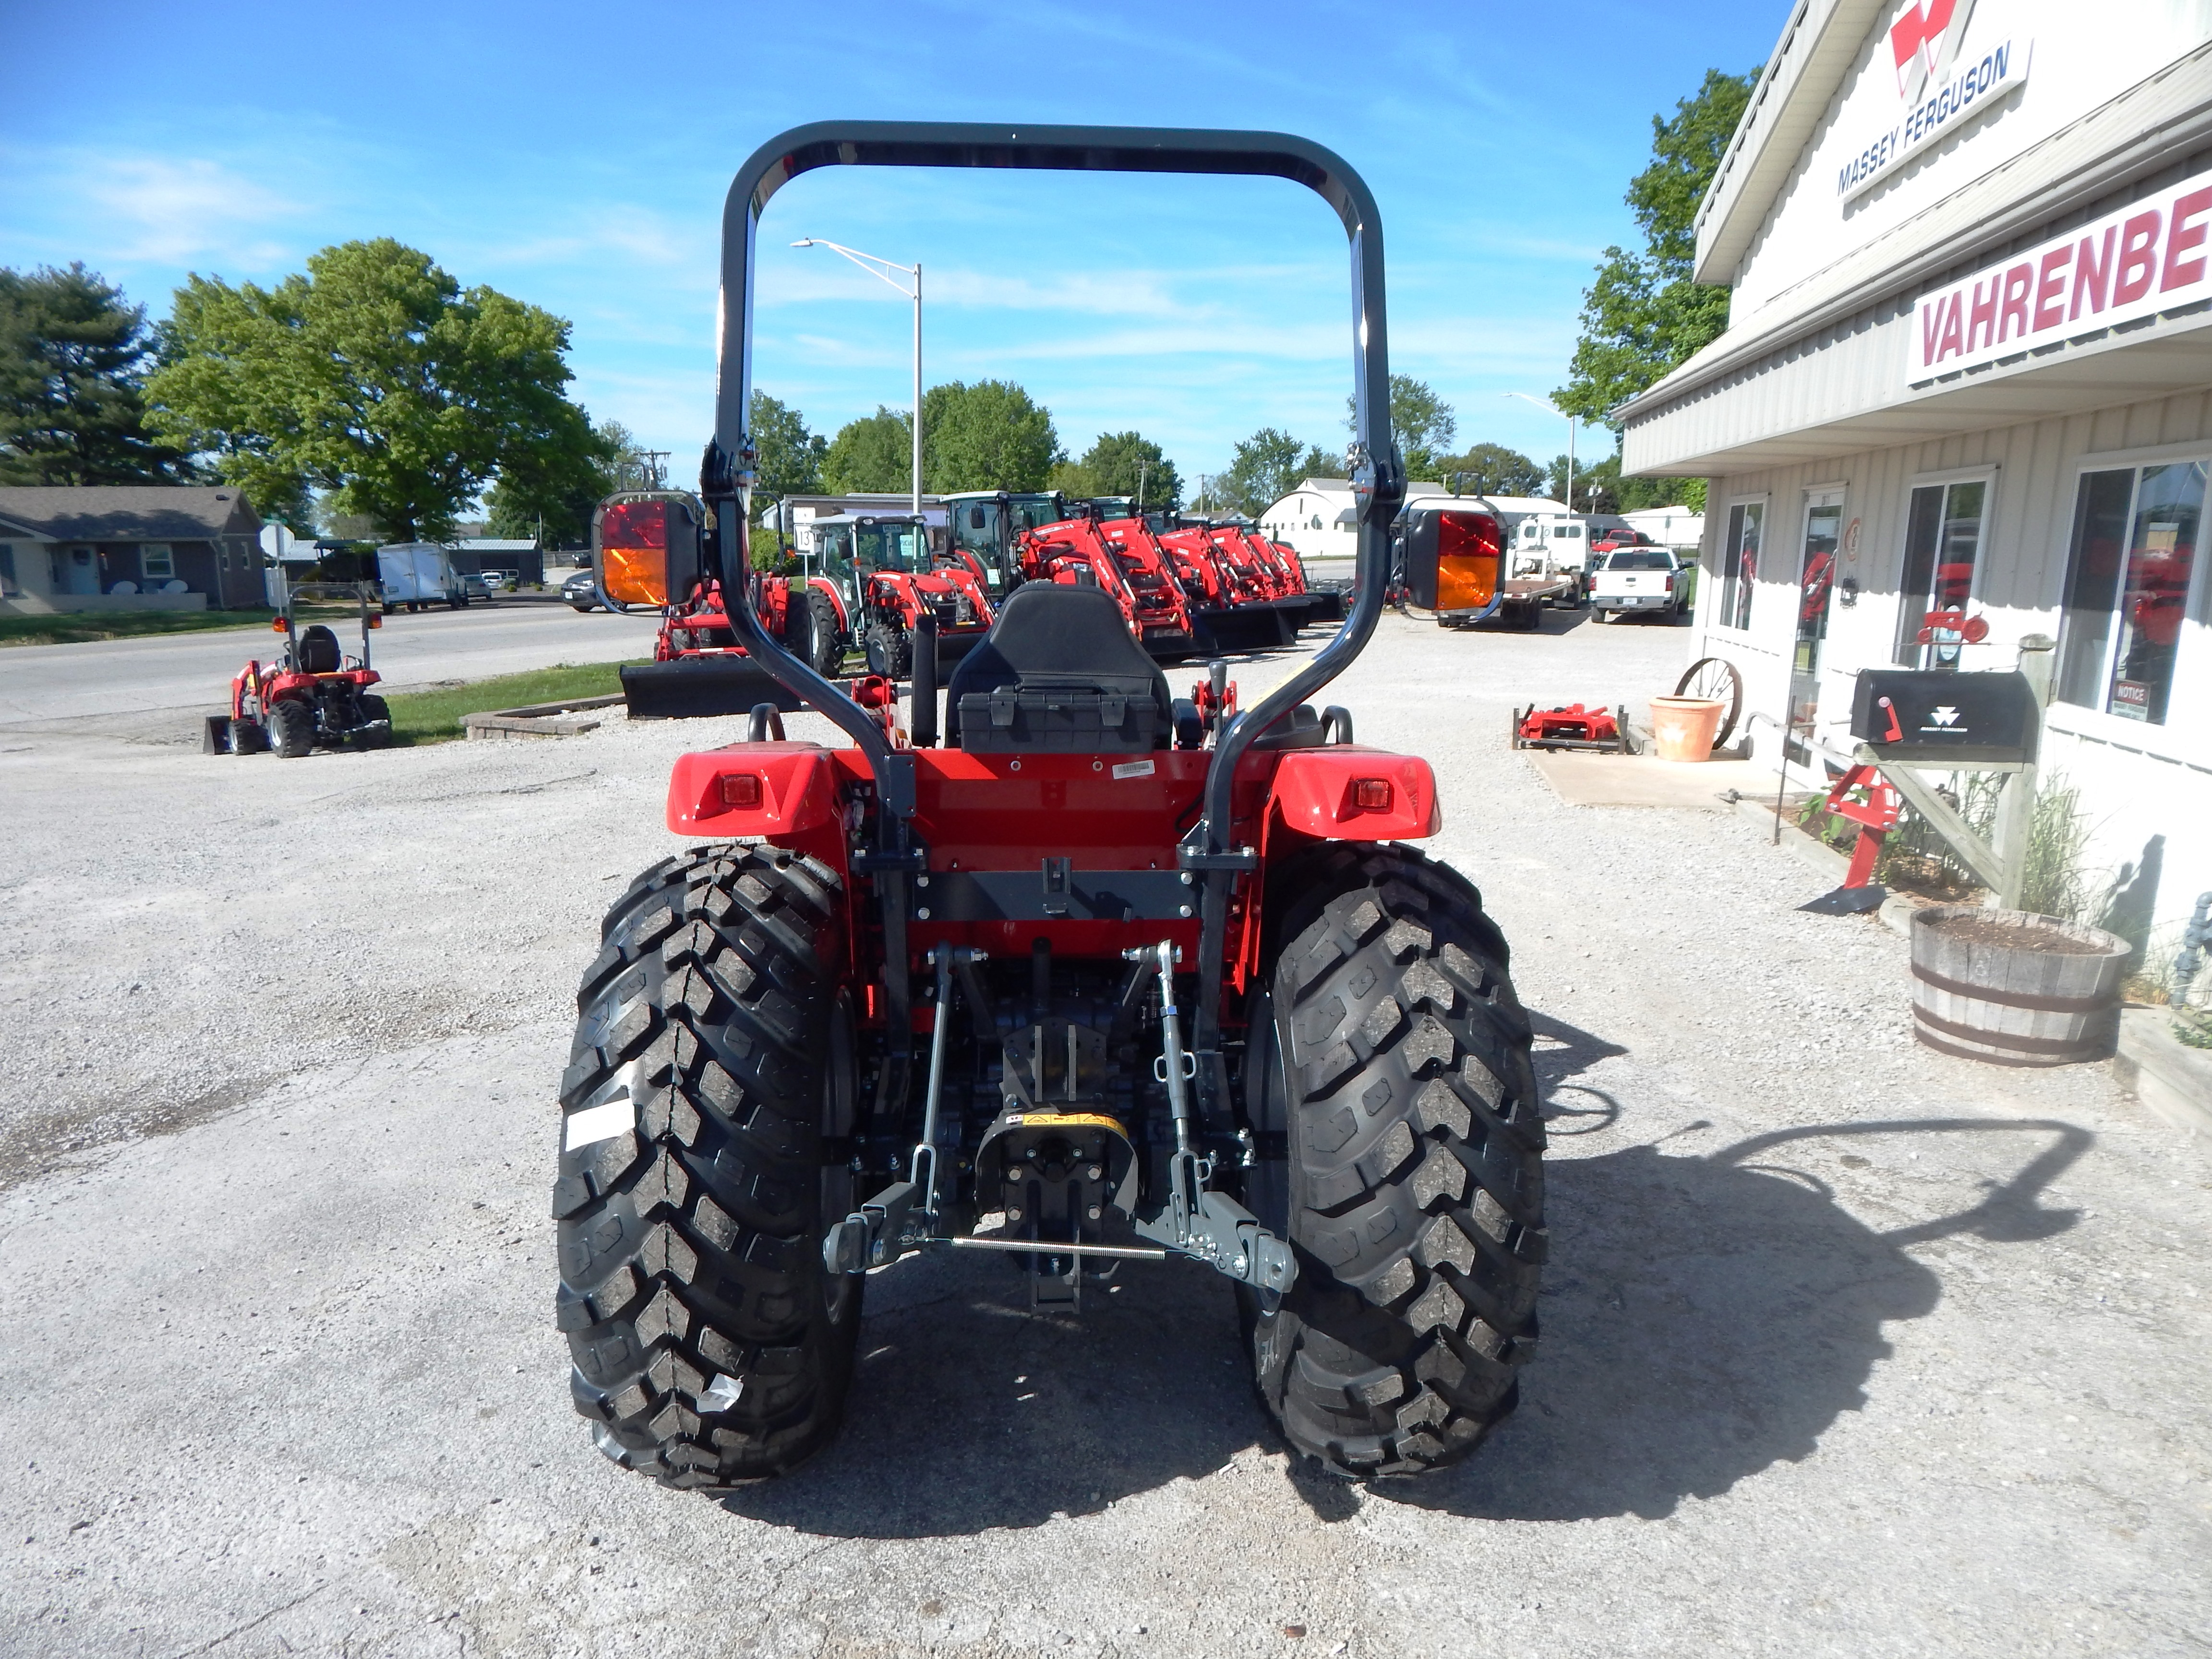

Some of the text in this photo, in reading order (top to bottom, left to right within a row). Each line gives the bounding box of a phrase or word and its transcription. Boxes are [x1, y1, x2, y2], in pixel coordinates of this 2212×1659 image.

[1838, 39, 2011, 197] MASSEY FERGUSON
[800, 530, 810, 546] 13
[2117, 685, 2145, 701] NOTICE
